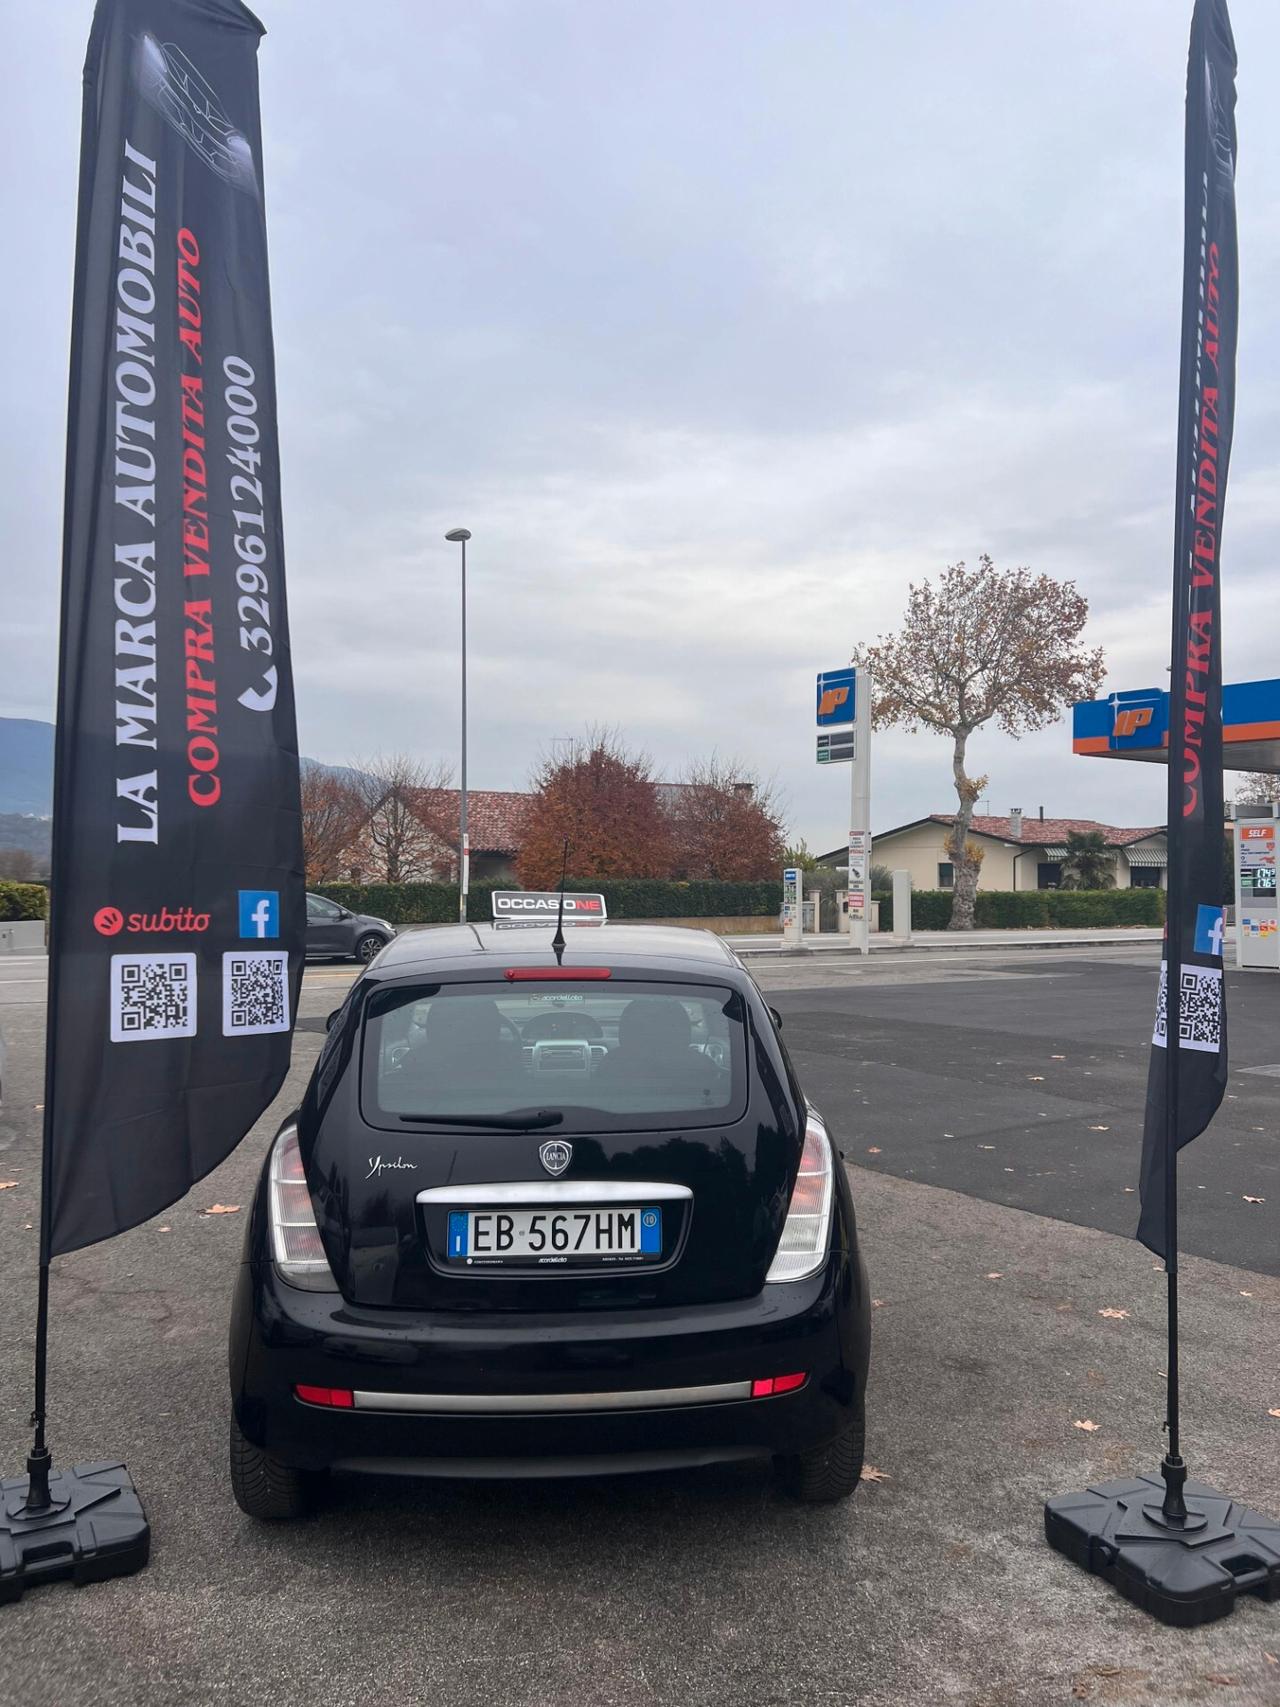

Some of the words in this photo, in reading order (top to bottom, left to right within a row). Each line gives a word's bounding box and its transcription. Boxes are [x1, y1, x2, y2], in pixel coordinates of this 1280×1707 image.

[115, 138, 157, 527] AUTOMOBILI
[177, 227, 203, 365] AUTO
[181, 373, 211, 577] VENDITA
[223, 355, 273, 657] 3296124000
[1192, 386, 1219, 588] VENDITA
[114, 541, 157, 750] MARCA
[184, 599, 221, 807] COMPRA
[116, 769, 159, 845] LA
[127, 907, 211, 933] subito
[497, 898, 601, 911] OCCASONE
[365, 1156, 418, 1179] Ypsilon
[545, 1153, 567, 1161] LANCIA
[473, 1215, 514, 1251] EB
[528, 1213, 636, 1251] 567HM
